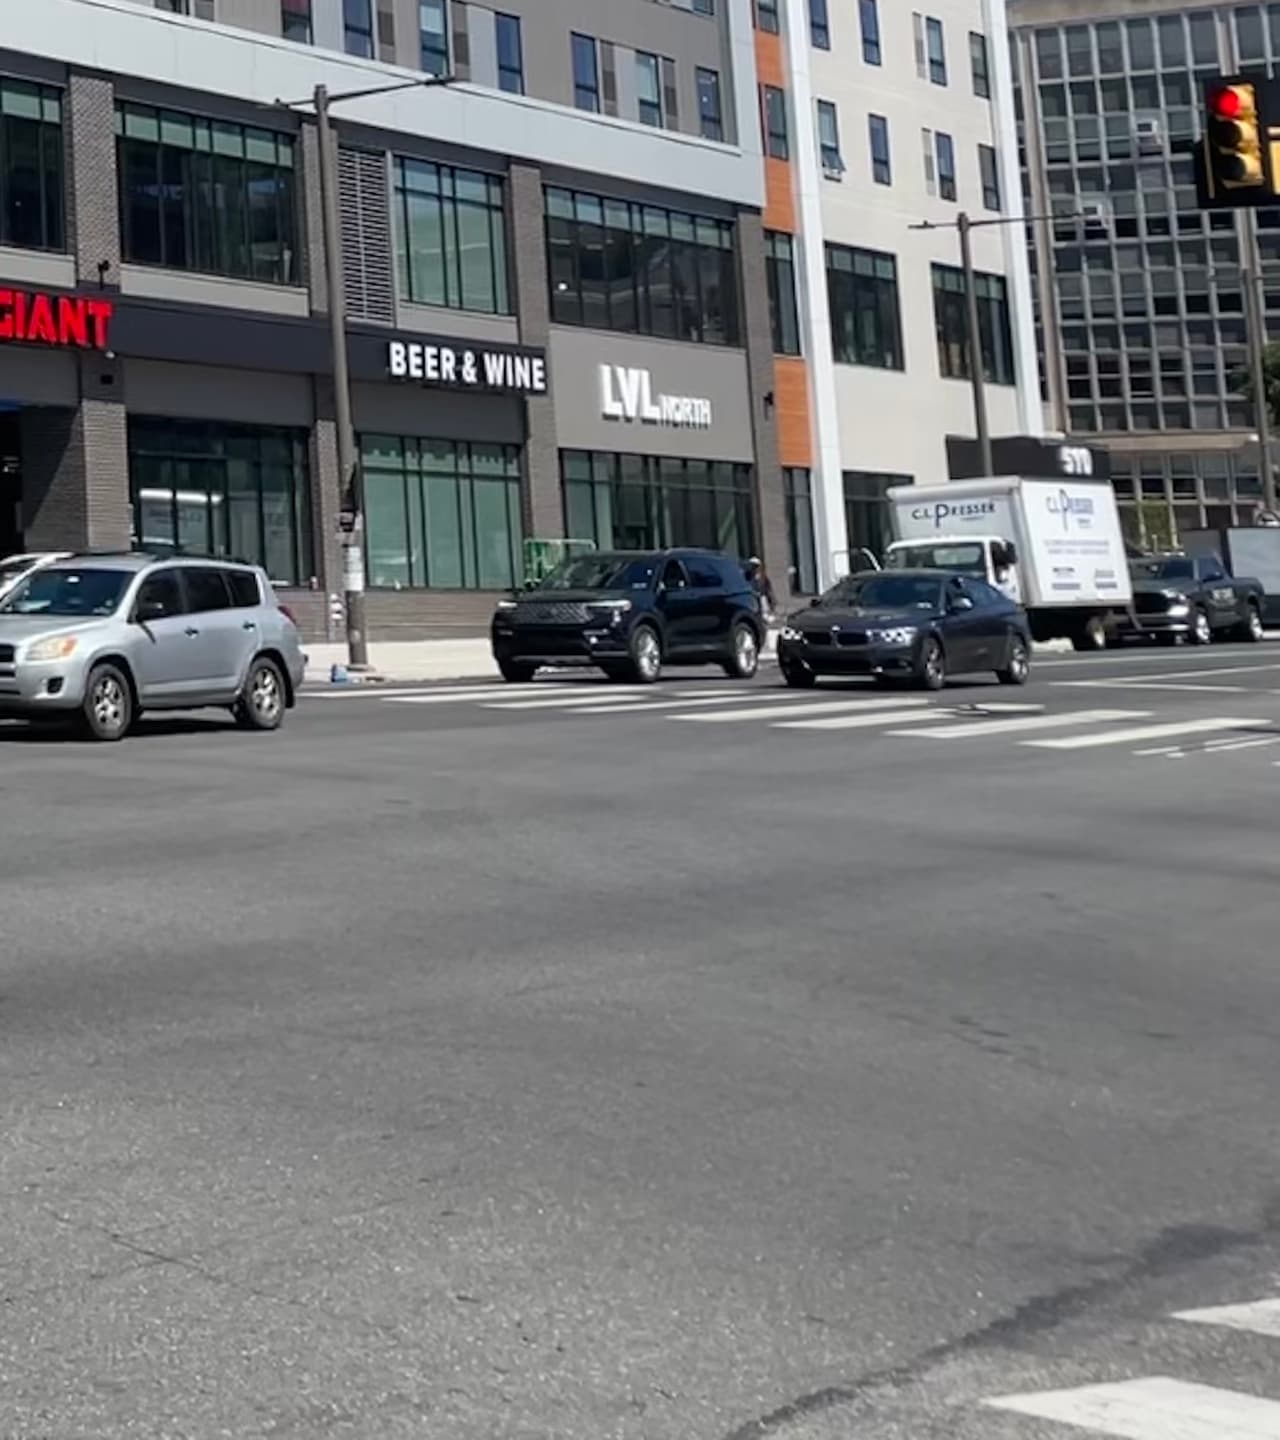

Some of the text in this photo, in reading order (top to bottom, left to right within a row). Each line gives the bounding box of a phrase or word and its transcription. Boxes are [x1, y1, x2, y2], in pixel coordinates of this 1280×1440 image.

[389, 342, 546, 391] BEER & WINE
[600, 363, 712, 425] LVL NORTH
